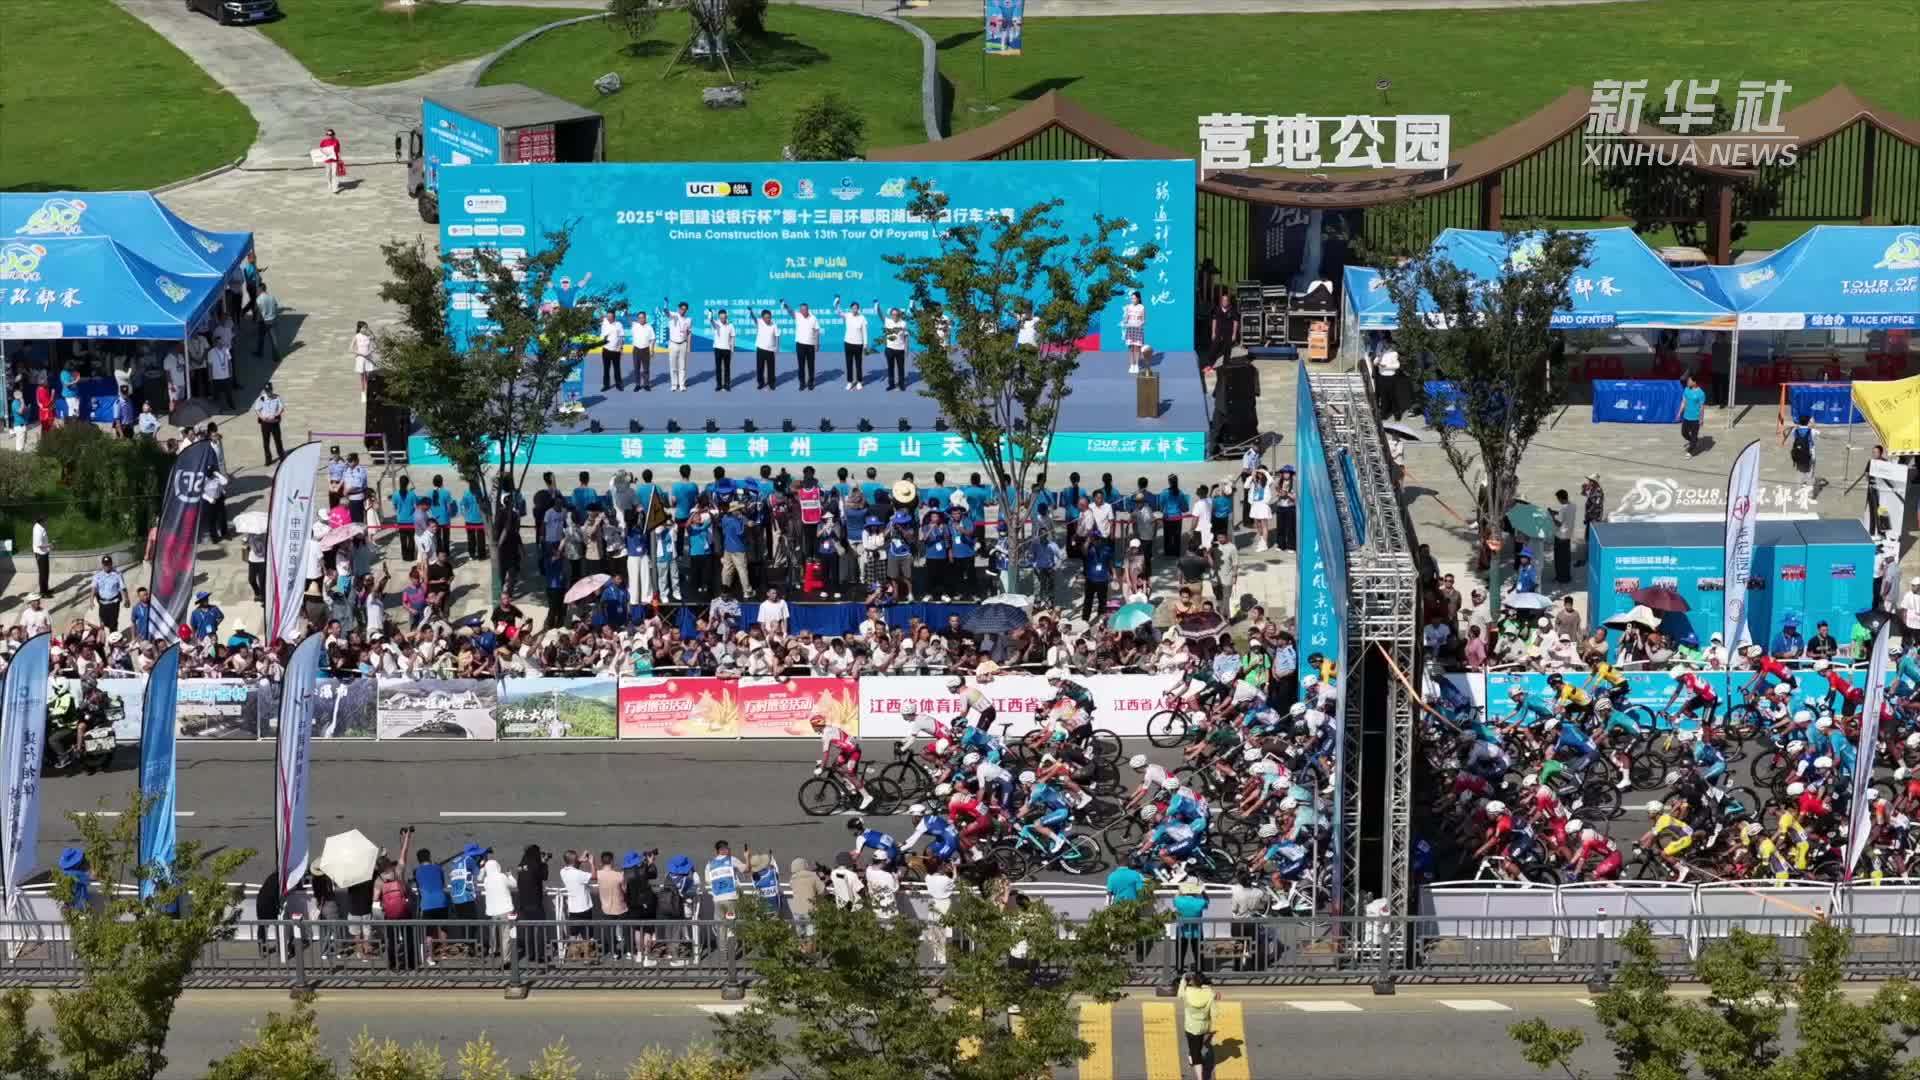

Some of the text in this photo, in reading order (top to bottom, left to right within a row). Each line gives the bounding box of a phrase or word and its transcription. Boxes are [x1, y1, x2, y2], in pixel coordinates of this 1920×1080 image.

[1198, 113, 1450, 169] 营地公园
[690, 184, 714, 194] UCI
[669, 229, 702, 240] China
[704, 229, 779, 240] Construction
[781, 229, 810, 240] Bank
[814, 229, 838, 239] 13th
[841, 229, 866, 239] Tour
[869, 229, 884, 239] Of
[886, 228, 929, 241] Poyang
[844, 270, 864, 280] City
[1840, 276, 1918, 289] TOUR OF
[1842, 286, 1889, 295] POYANG
[1811, 314, 1915, 326] 综合办 RACE OFFICE
[117, 324, 139, 336] VIP
[1677, 488, 1721, 499] TOUR
